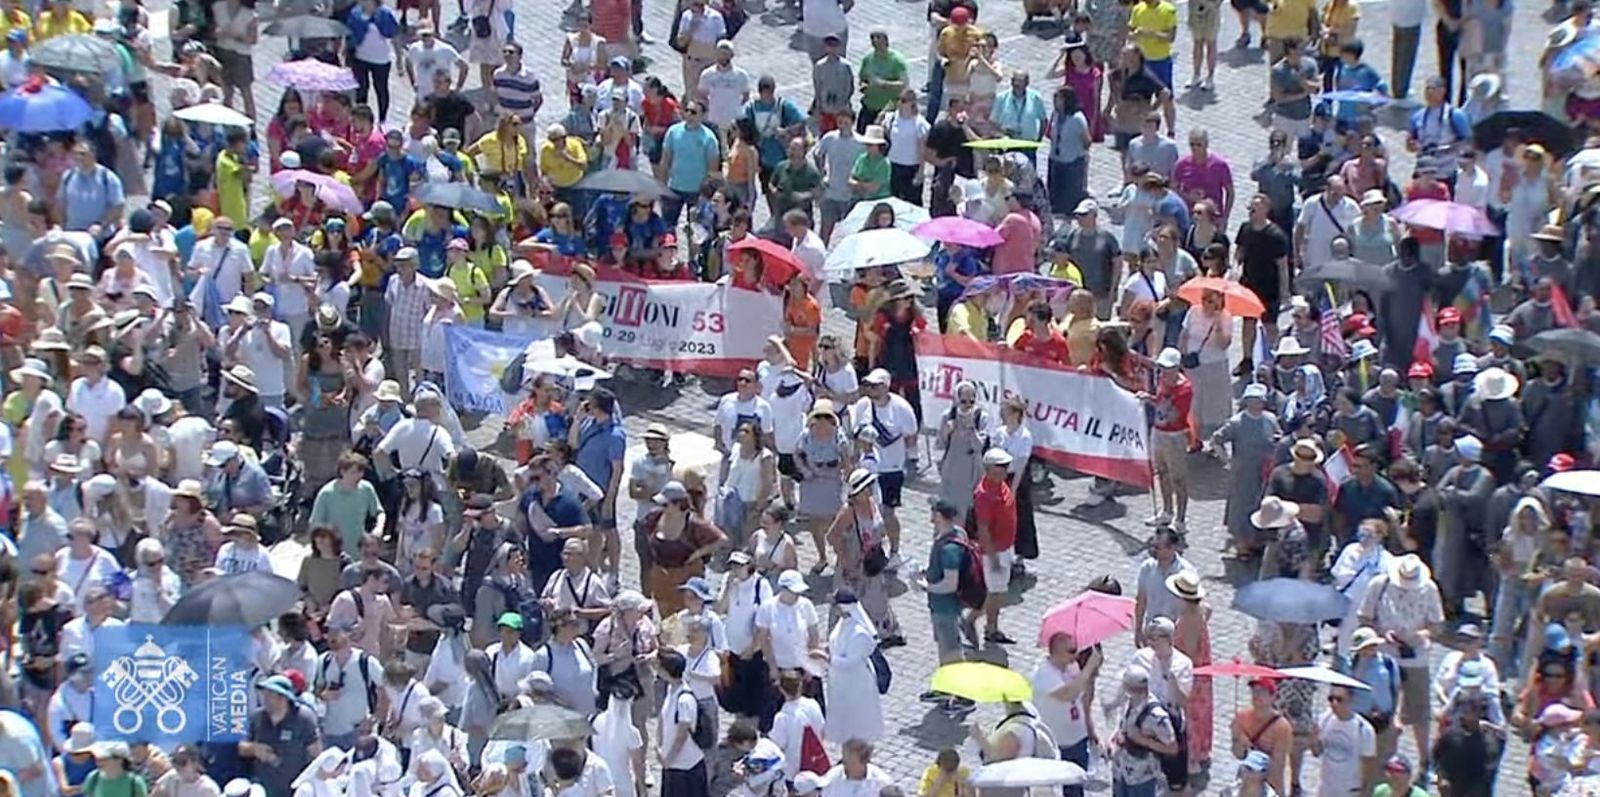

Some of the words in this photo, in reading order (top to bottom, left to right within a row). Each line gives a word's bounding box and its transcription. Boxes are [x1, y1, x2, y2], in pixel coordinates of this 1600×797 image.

[691, 311, 725, 334] 53
[678, 340, 716, 355] 2023
[1003, 389, 1079, 432] SLUTA
[1084, 417, 1104, 439] IL
[1108, 423, 1145, 451] PAPA
